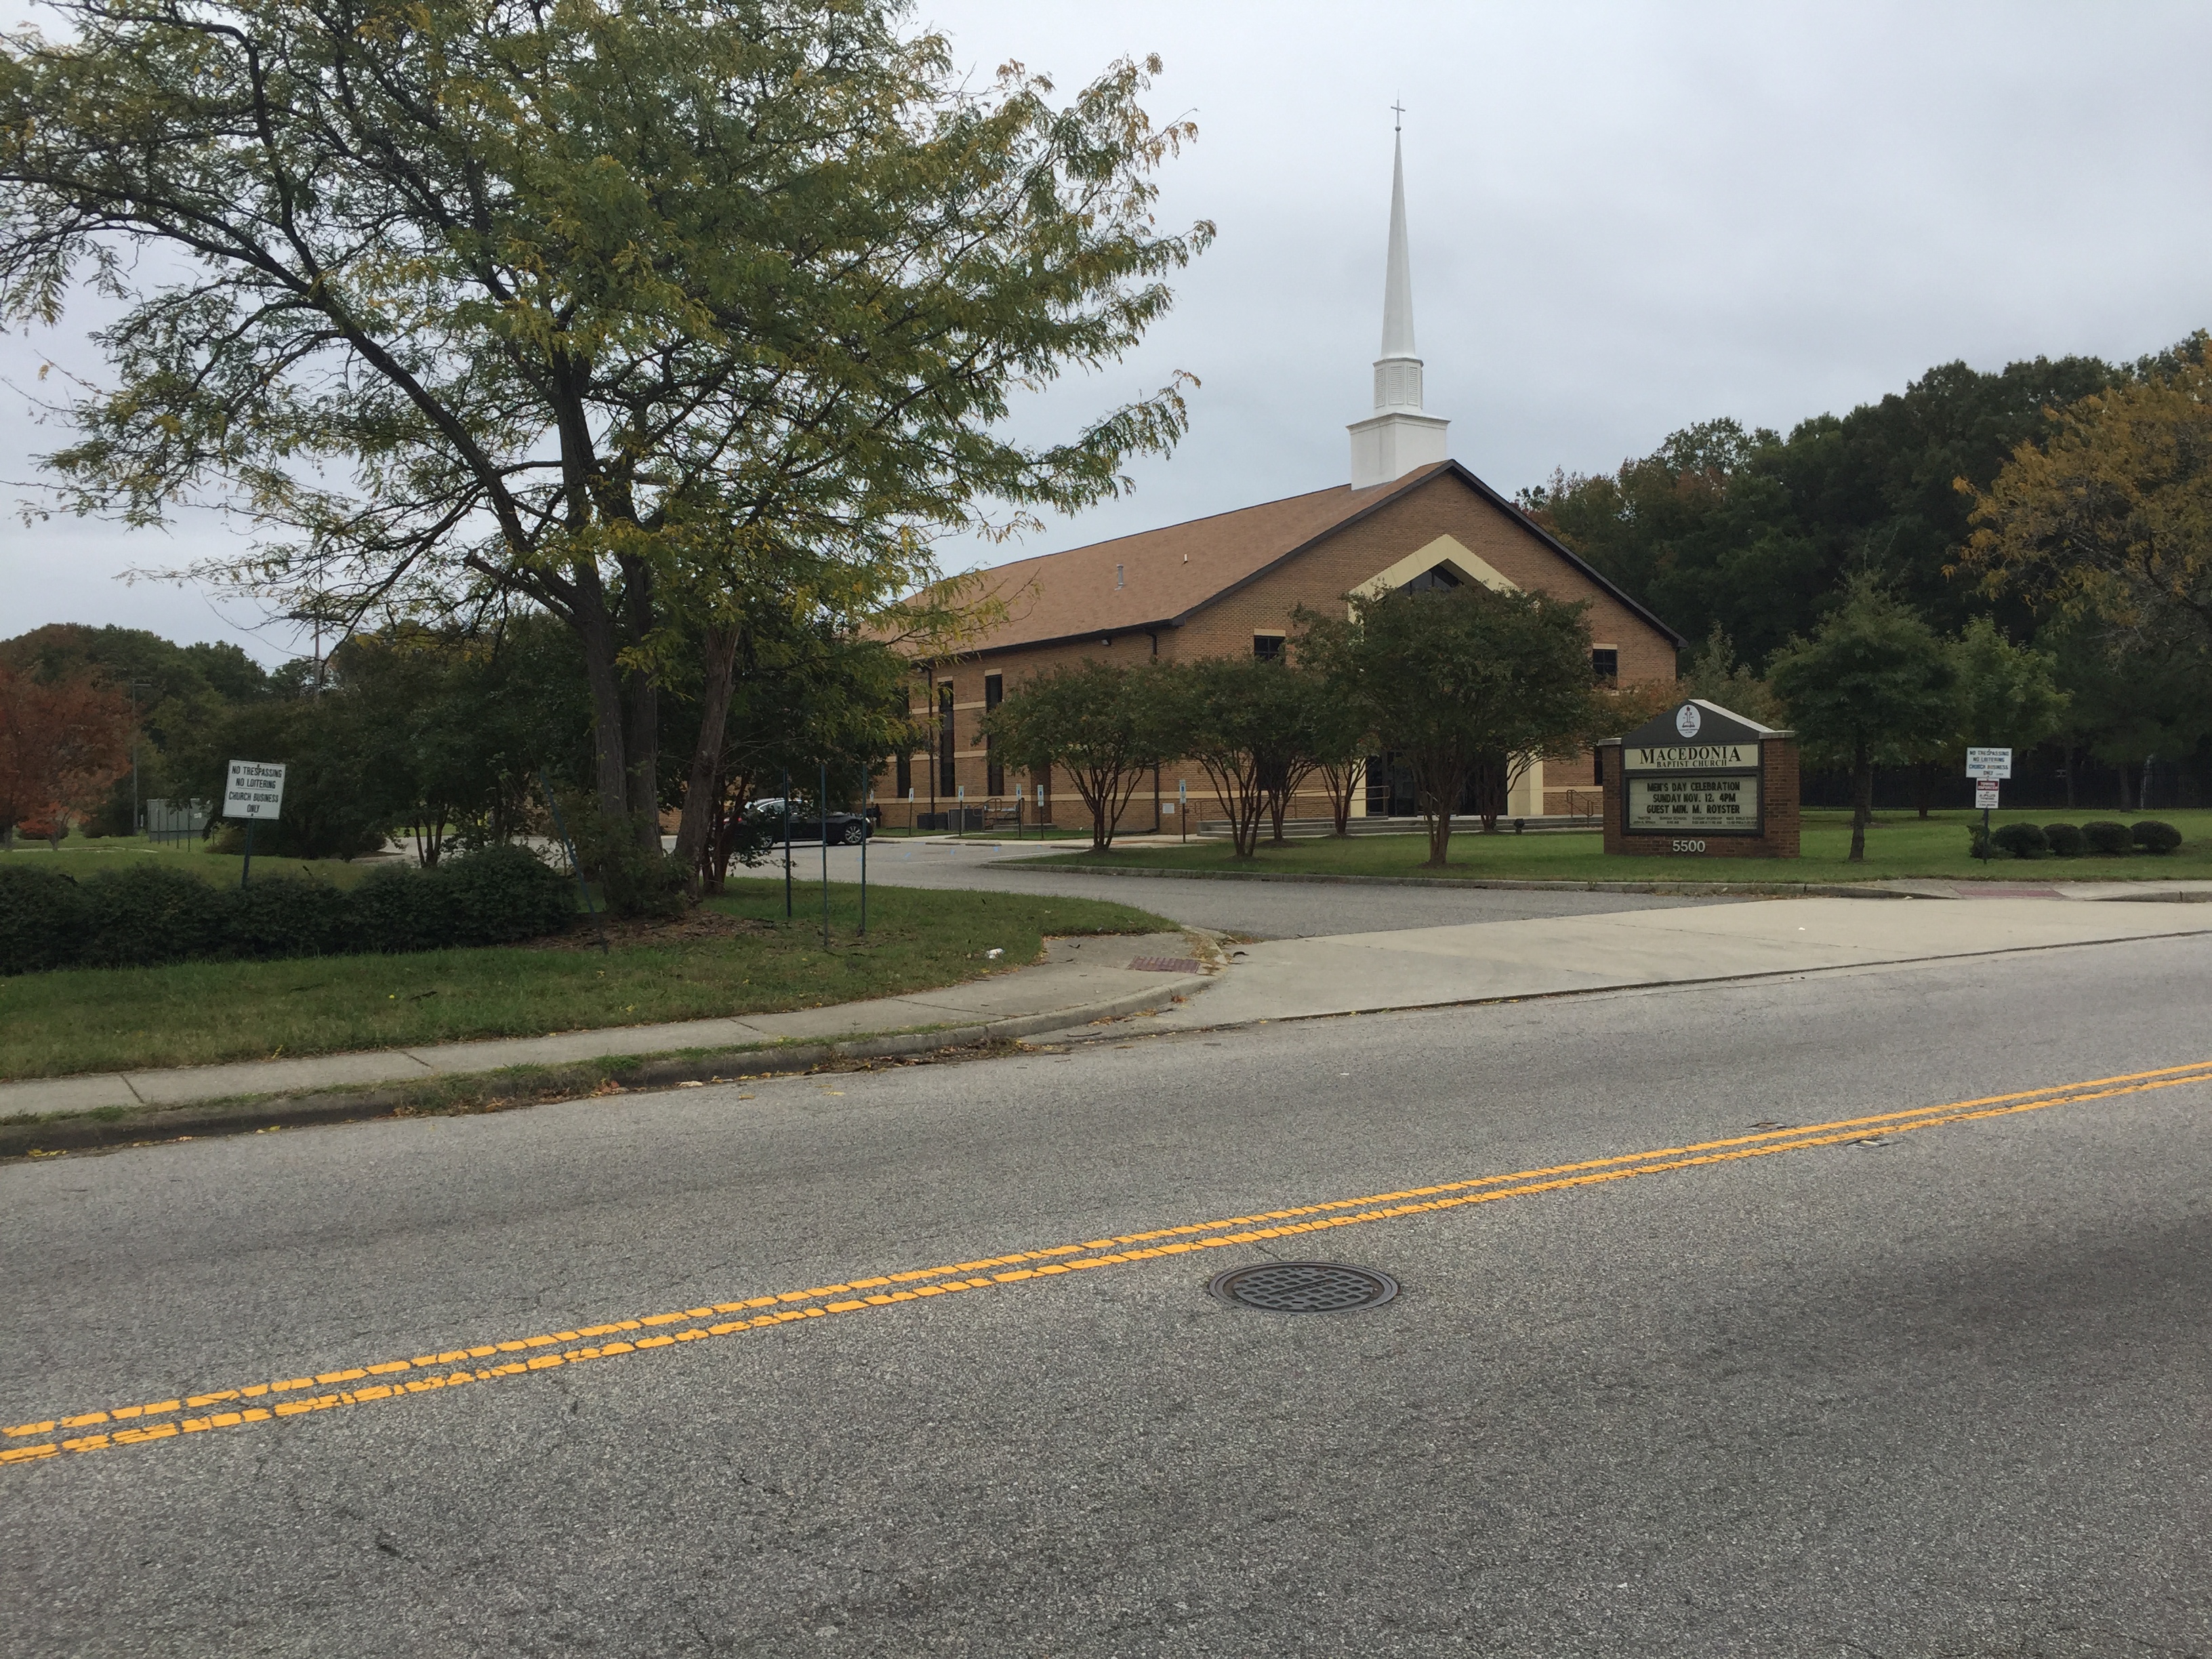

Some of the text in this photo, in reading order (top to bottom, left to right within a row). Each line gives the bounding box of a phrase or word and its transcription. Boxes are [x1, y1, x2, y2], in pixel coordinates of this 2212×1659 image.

[1640, 746, 1741, 764] MACEDONIA
[1692, 759, 1727, 767] CHURCH
[232, 766, 282, 777] NO TRESPASSING
[236, 778, 276, 789] NO LOITERING
[1647, 781, 1740, 792] MEN'S DAY CELEBRATION
[229, 792, 279, 802] CHURCH BUSINESS
[1653, 794, 1681, 802] SUNDAY
[1683, 794, 1700, 802] NOV.
[1719, 793, 1736, 802] 4PM
[247, 804, 260, 813] ONLY
[1647, 804, 1740, 814] GUEST MIN. M. ROYSTER
[1673, 840, 1706, 853] 5500
